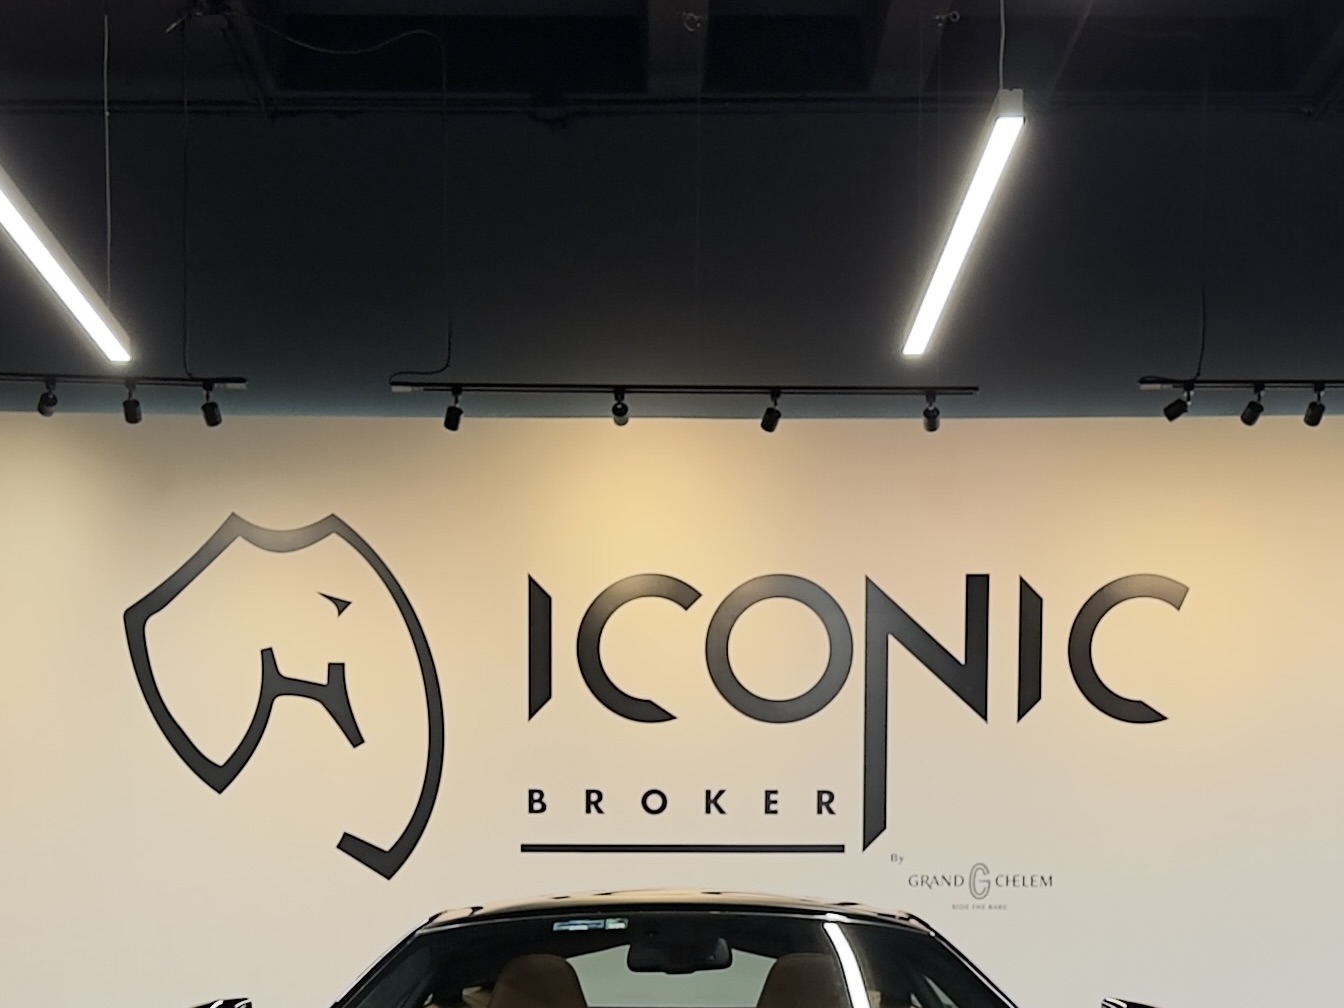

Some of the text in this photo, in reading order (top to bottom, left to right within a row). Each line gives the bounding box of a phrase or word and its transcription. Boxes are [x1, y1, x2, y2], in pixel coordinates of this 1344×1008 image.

[527, 573, 1190, 852] ICONIC
[527, 788, 836, 816] BROKER
[890, 853, 904, 865] By
[908, 874, 965, 889] GRAND
[994, 874, 1053, 888] CHELEM
